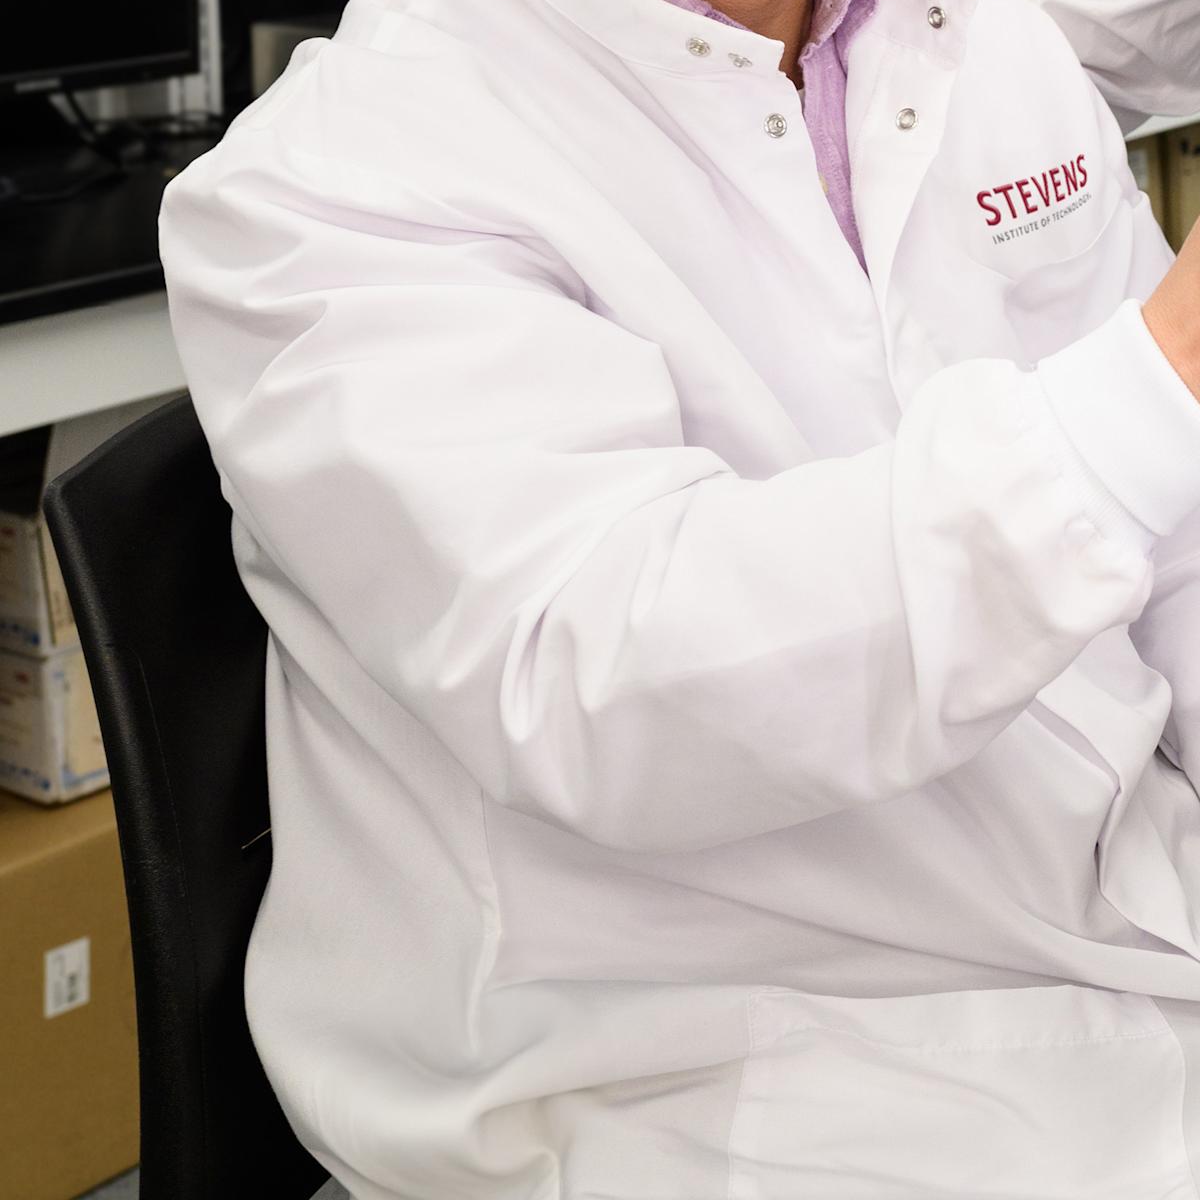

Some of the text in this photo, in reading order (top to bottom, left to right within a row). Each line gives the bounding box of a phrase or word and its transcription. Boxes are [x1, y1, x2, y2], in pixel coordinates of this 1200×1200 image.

[976, 153, 1088, 227] STEVENS
[991, 191, 1091, 245] INSTITUTE OF TECHNOLOGY
